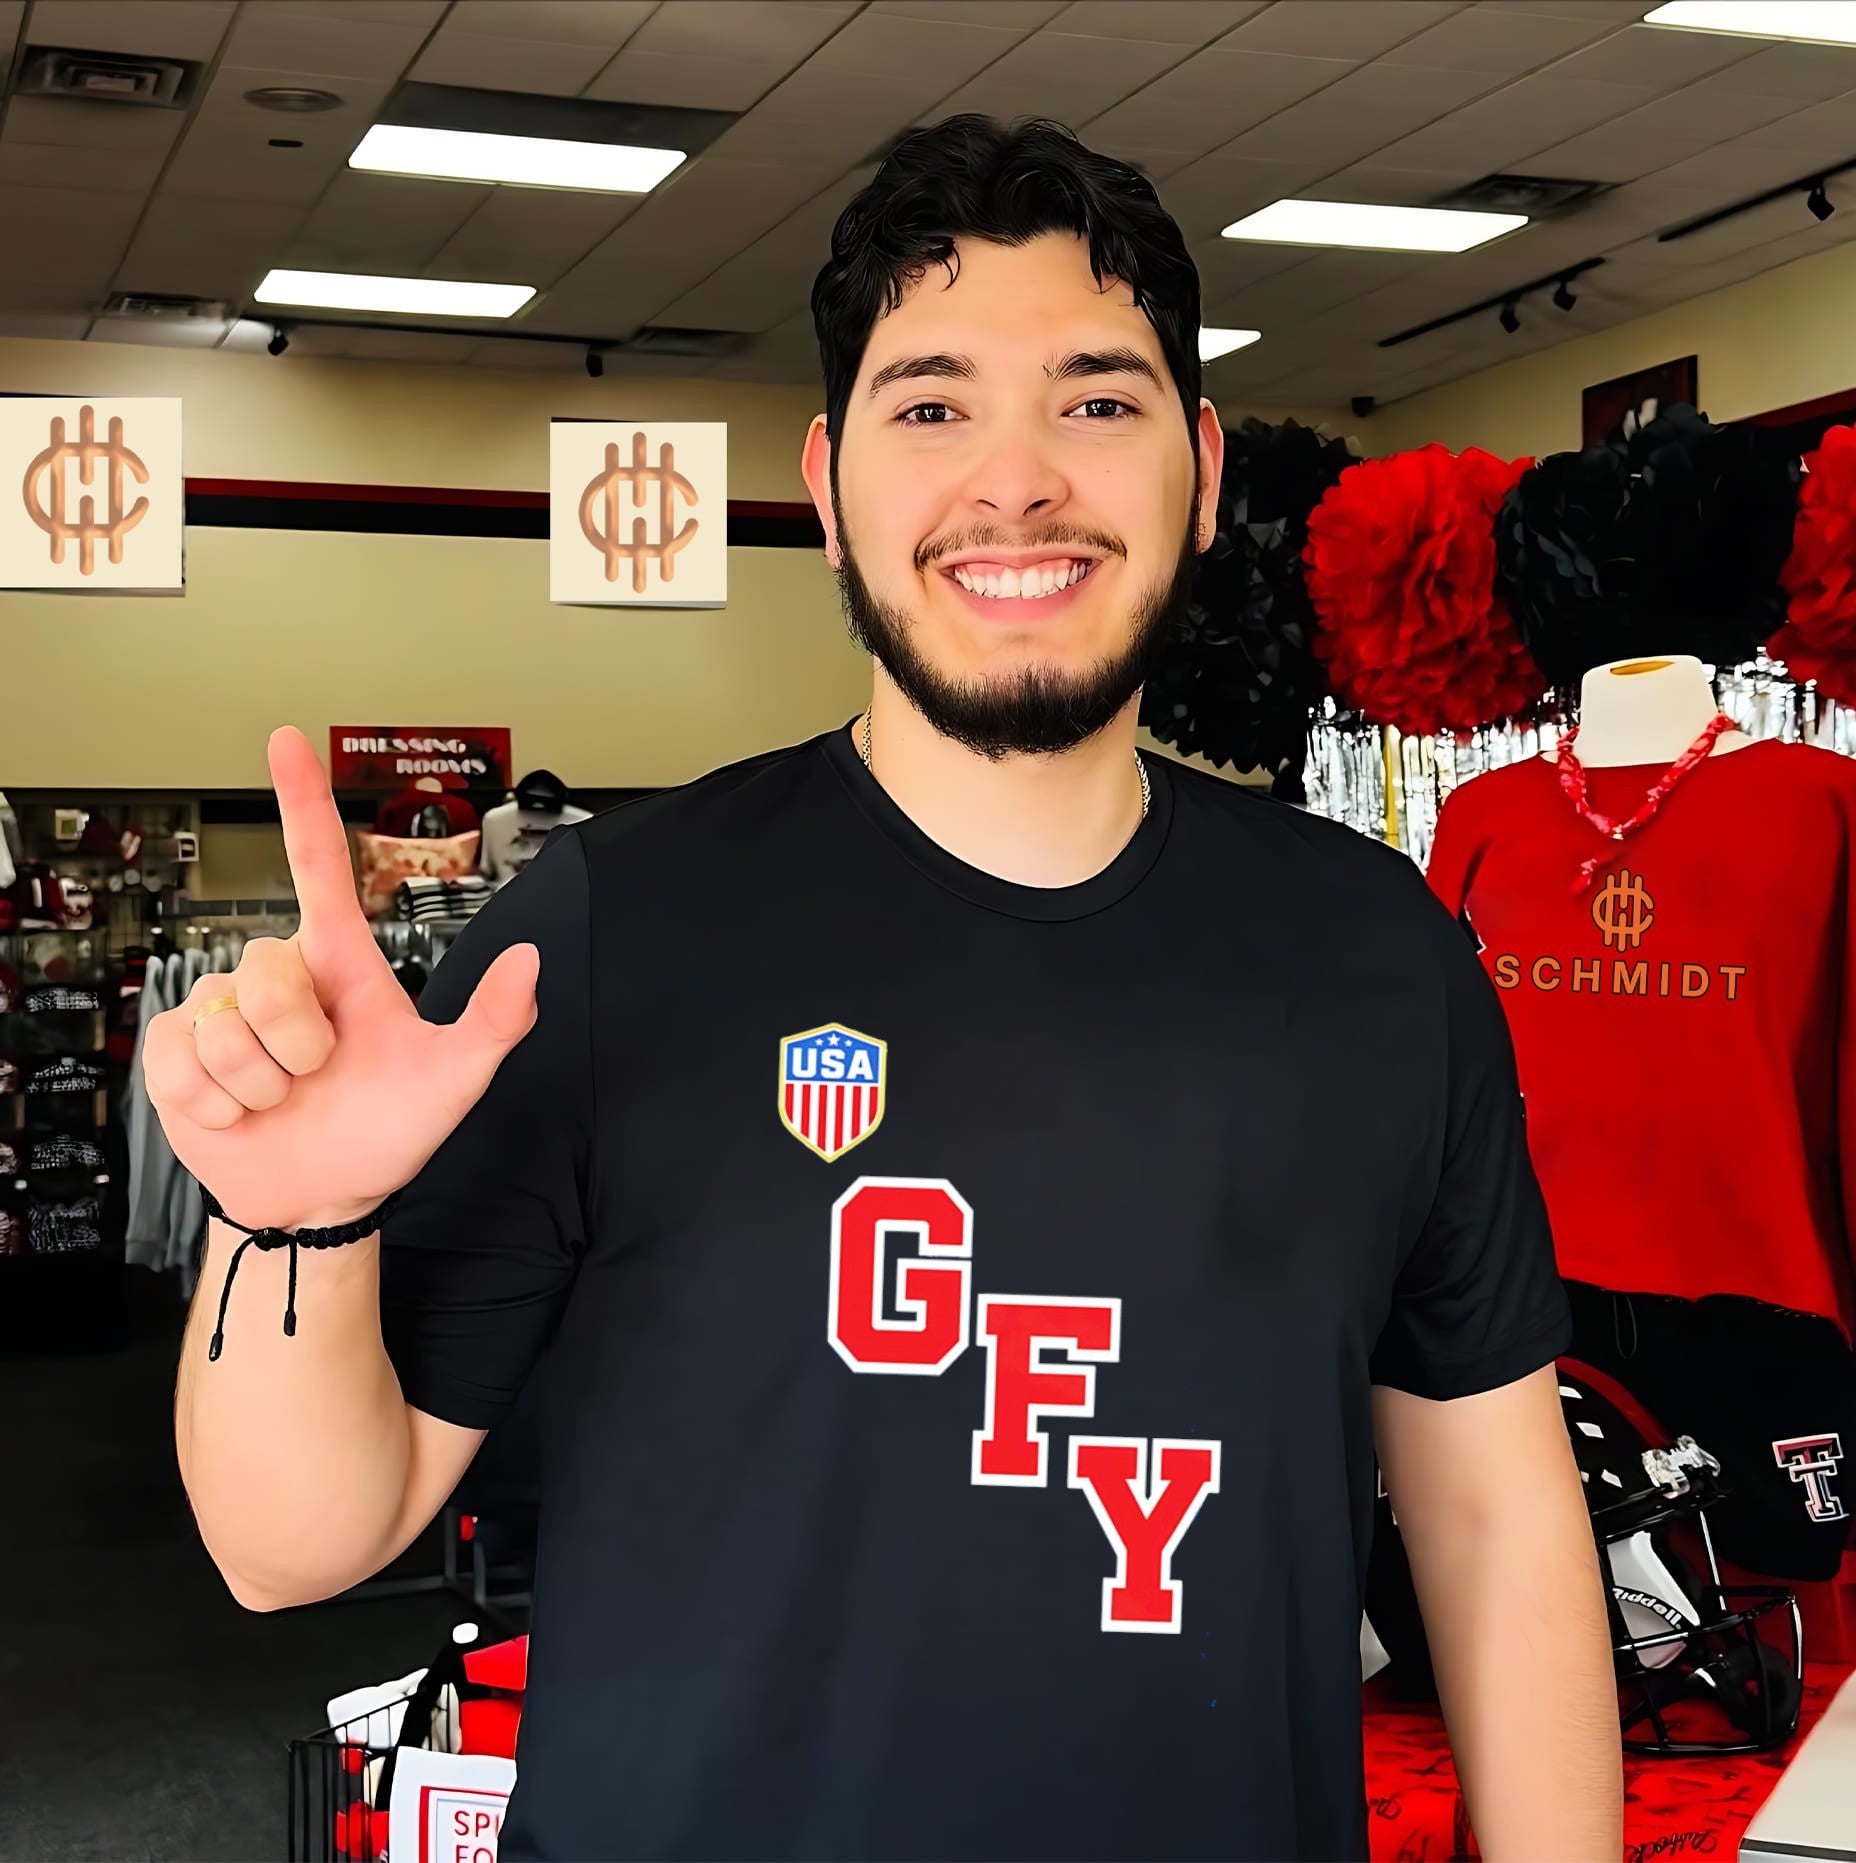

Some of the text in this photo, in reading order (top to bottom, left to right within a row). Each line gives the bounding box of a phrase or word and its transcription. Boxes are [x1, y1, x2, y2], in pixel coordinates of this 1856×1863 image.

[396, 758, 487, 775] ROOMS
[1494, 953, 1747, 1001] SCHMIDT
[792, 1047, 874, 1080] USA
